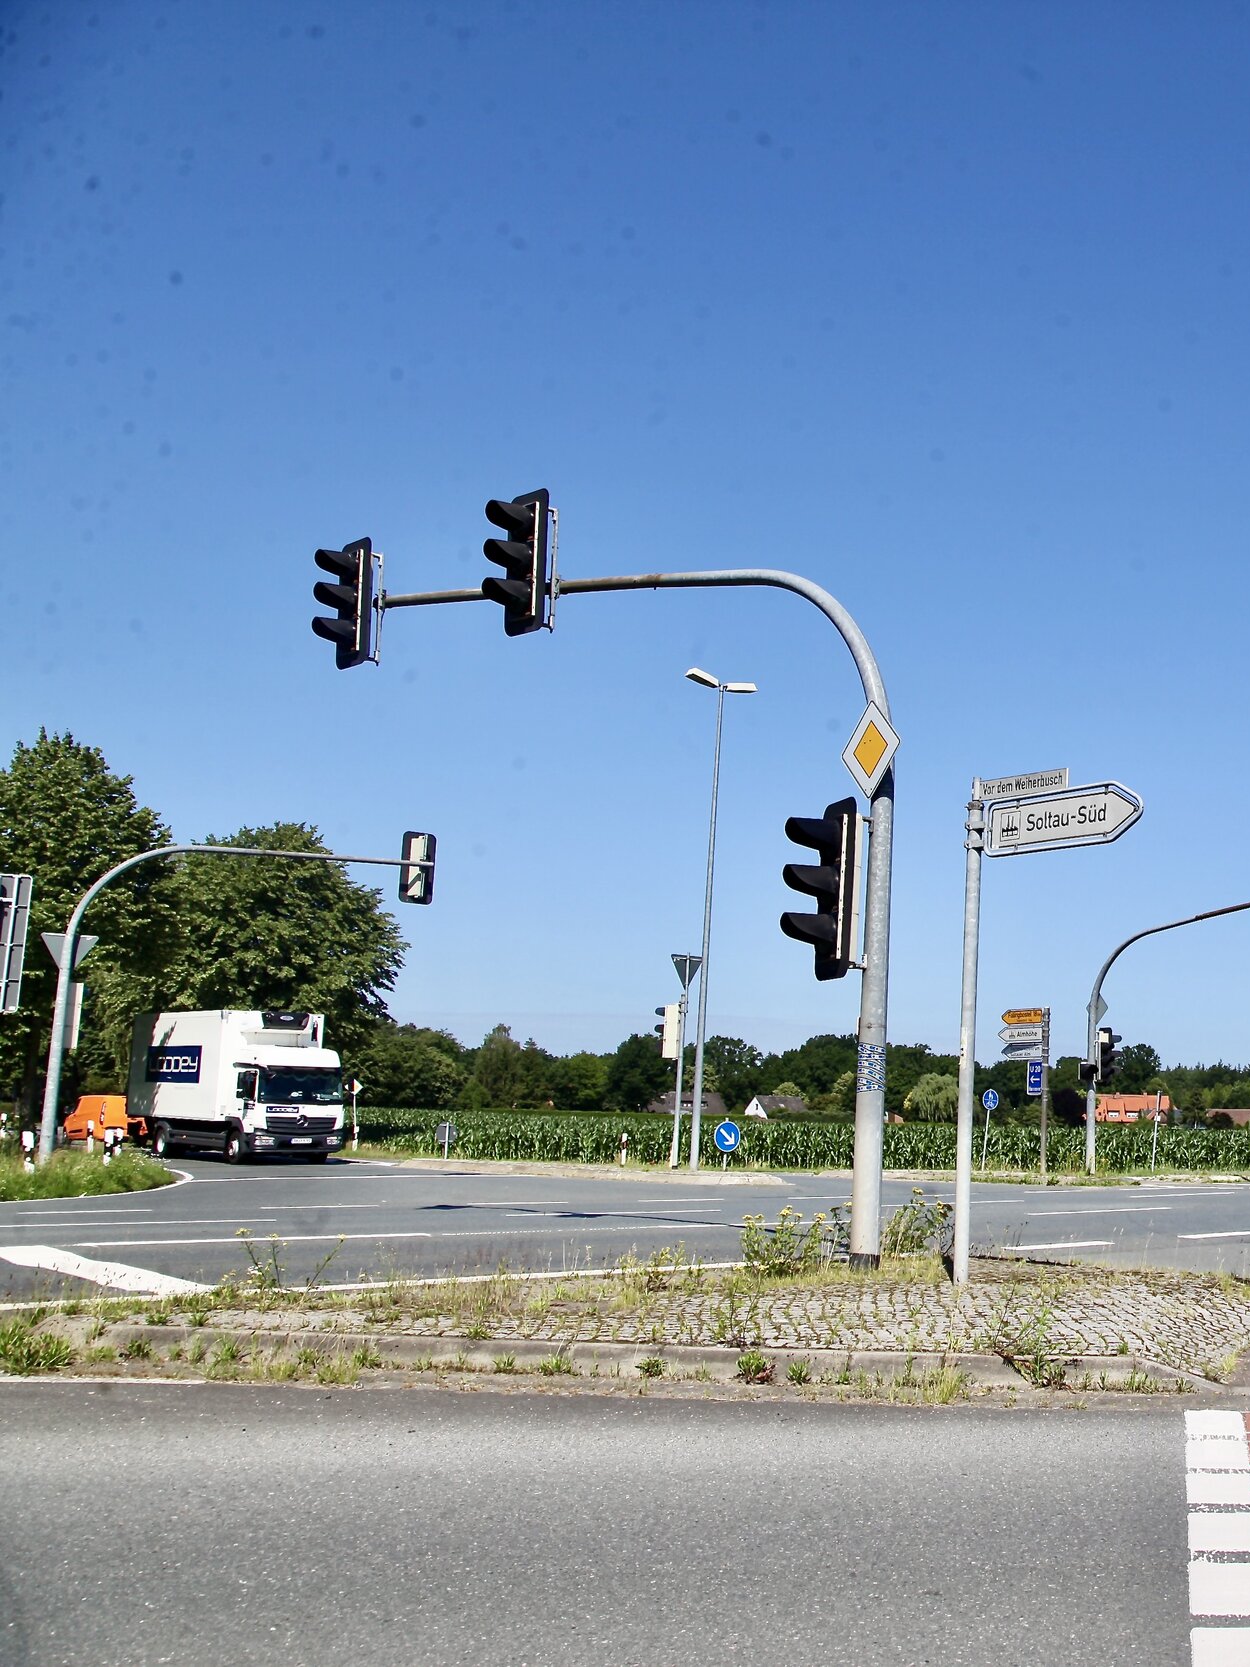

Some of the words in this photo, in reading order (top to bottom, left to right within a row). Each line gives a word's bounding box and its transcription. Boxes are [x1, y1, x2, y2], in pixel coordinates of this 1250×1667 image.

[983, 784, 995, 795] Vor
[997, 781, 1012, 794] dem
[1015, 772, 1063, 791] Weiherbusch
[1026, 803, 1107, 832] Soltau-Süd
